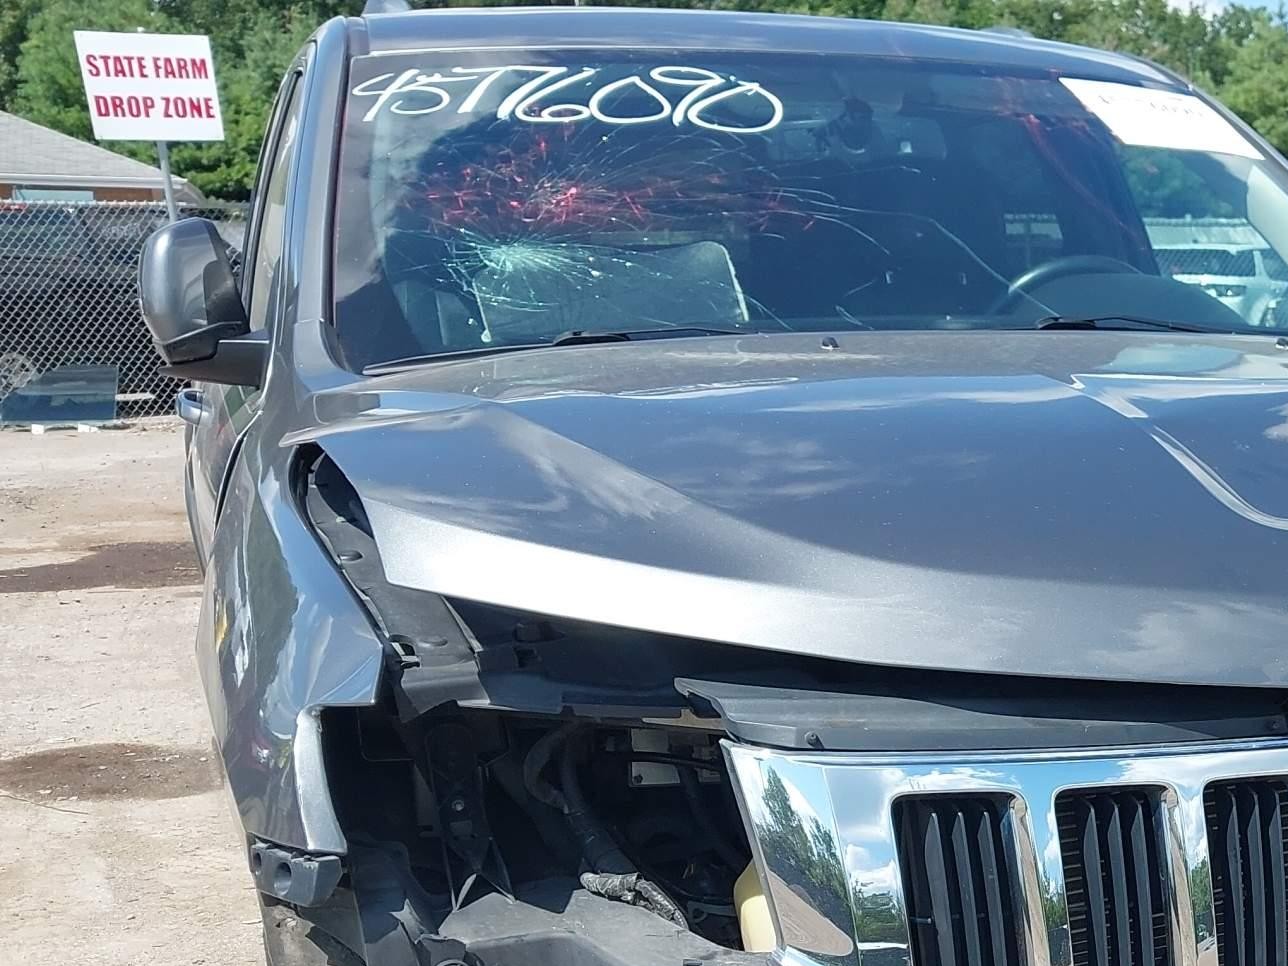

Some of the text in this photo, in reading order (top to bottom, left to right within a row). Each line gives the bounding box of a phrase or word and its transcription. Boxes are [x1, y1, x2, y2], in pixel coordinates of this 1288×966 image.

[86, 54, 209, 80] STATE FARM
[94, 95, 216, 119] DROP ZONE
[351, 65, 785, 133] 45776090
